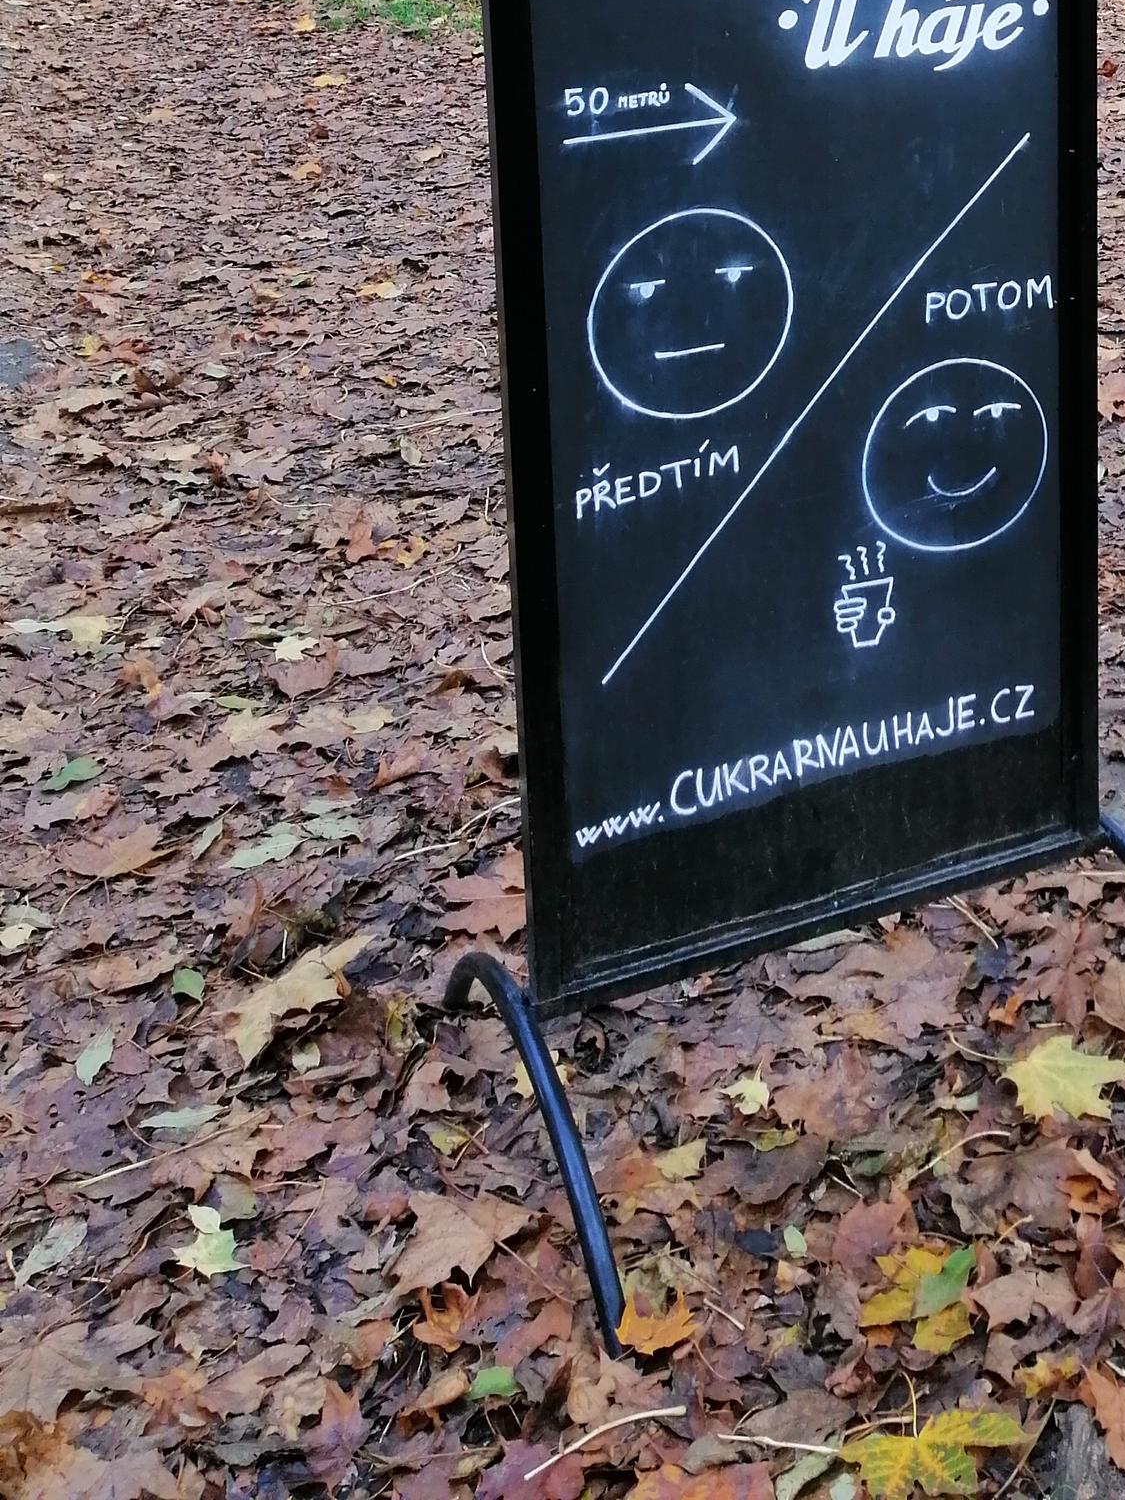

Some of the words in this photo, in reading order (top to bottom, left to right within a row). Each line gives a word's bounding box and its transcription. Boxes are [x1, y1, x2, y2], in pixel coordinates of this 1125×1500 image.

[564, 85, 609, 117] 50
[925, 275, 1054, 324] POTOM
[575, 439, 740, 520] PŘEDTÍM
